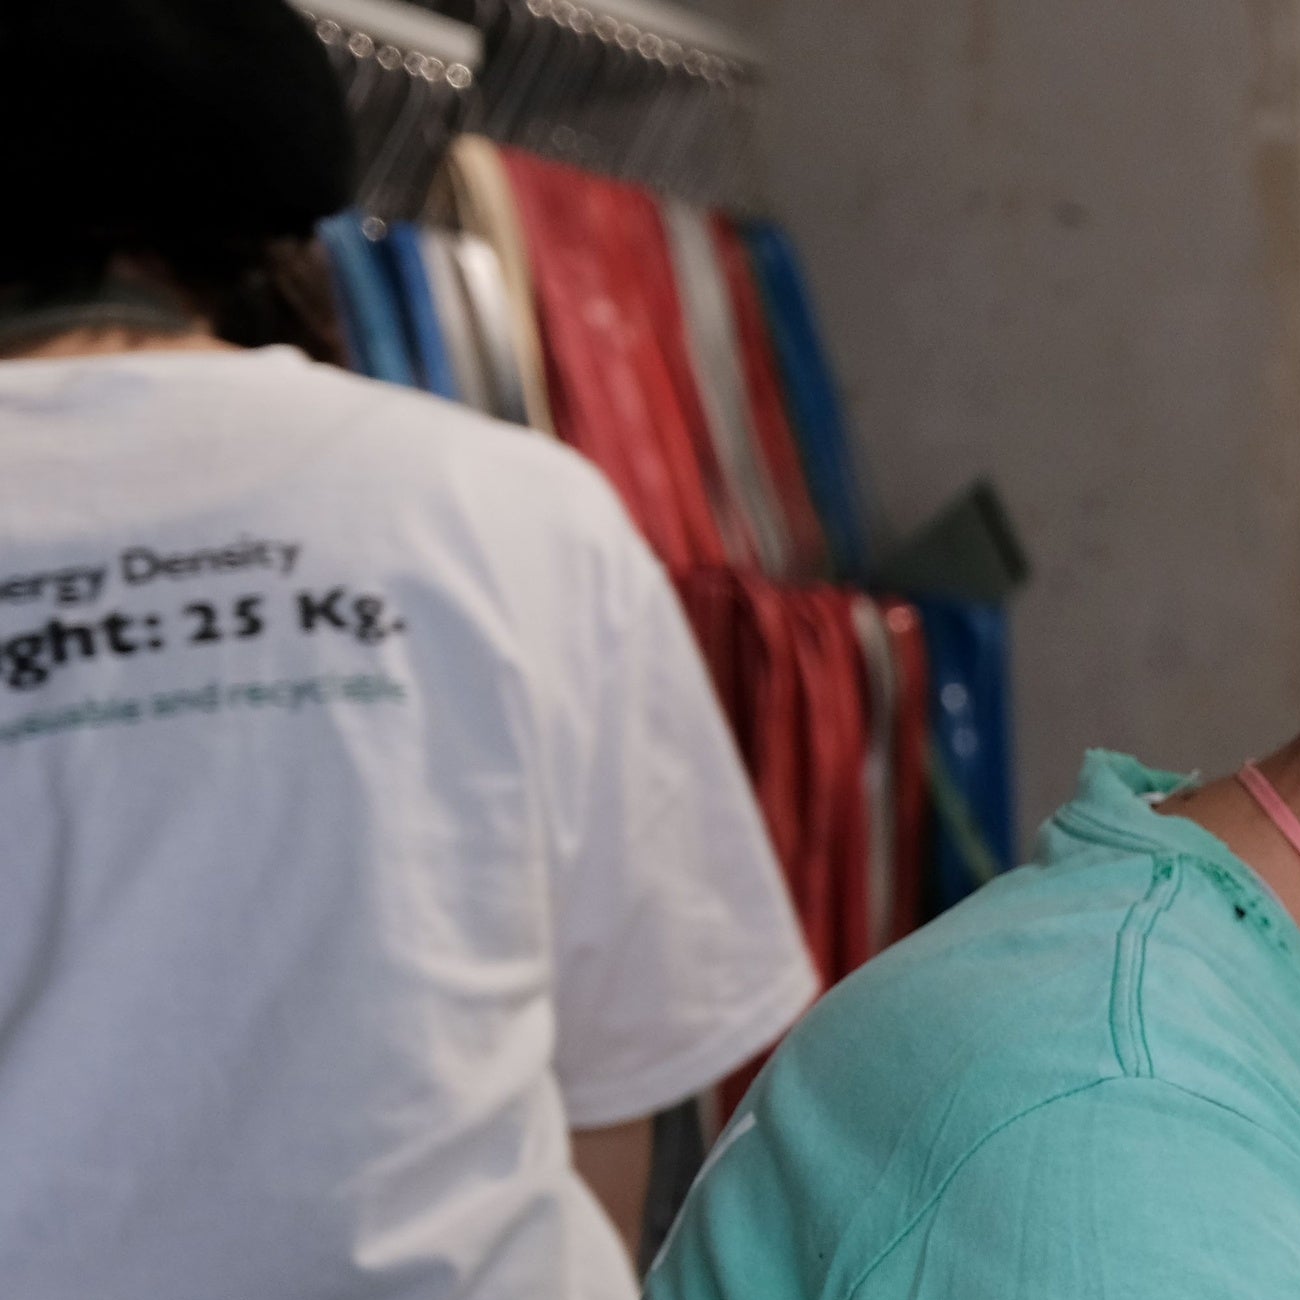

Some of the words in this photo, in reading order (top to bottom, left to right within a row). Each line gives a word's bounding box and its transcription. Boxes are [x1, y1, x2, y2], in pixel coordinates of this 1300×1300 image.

[121, 537, 301, 586] Density
[0, 610, 162, 692] ght:
[184, 593, 264, 643] 25
[297, 585, 407, 644] Kg.
